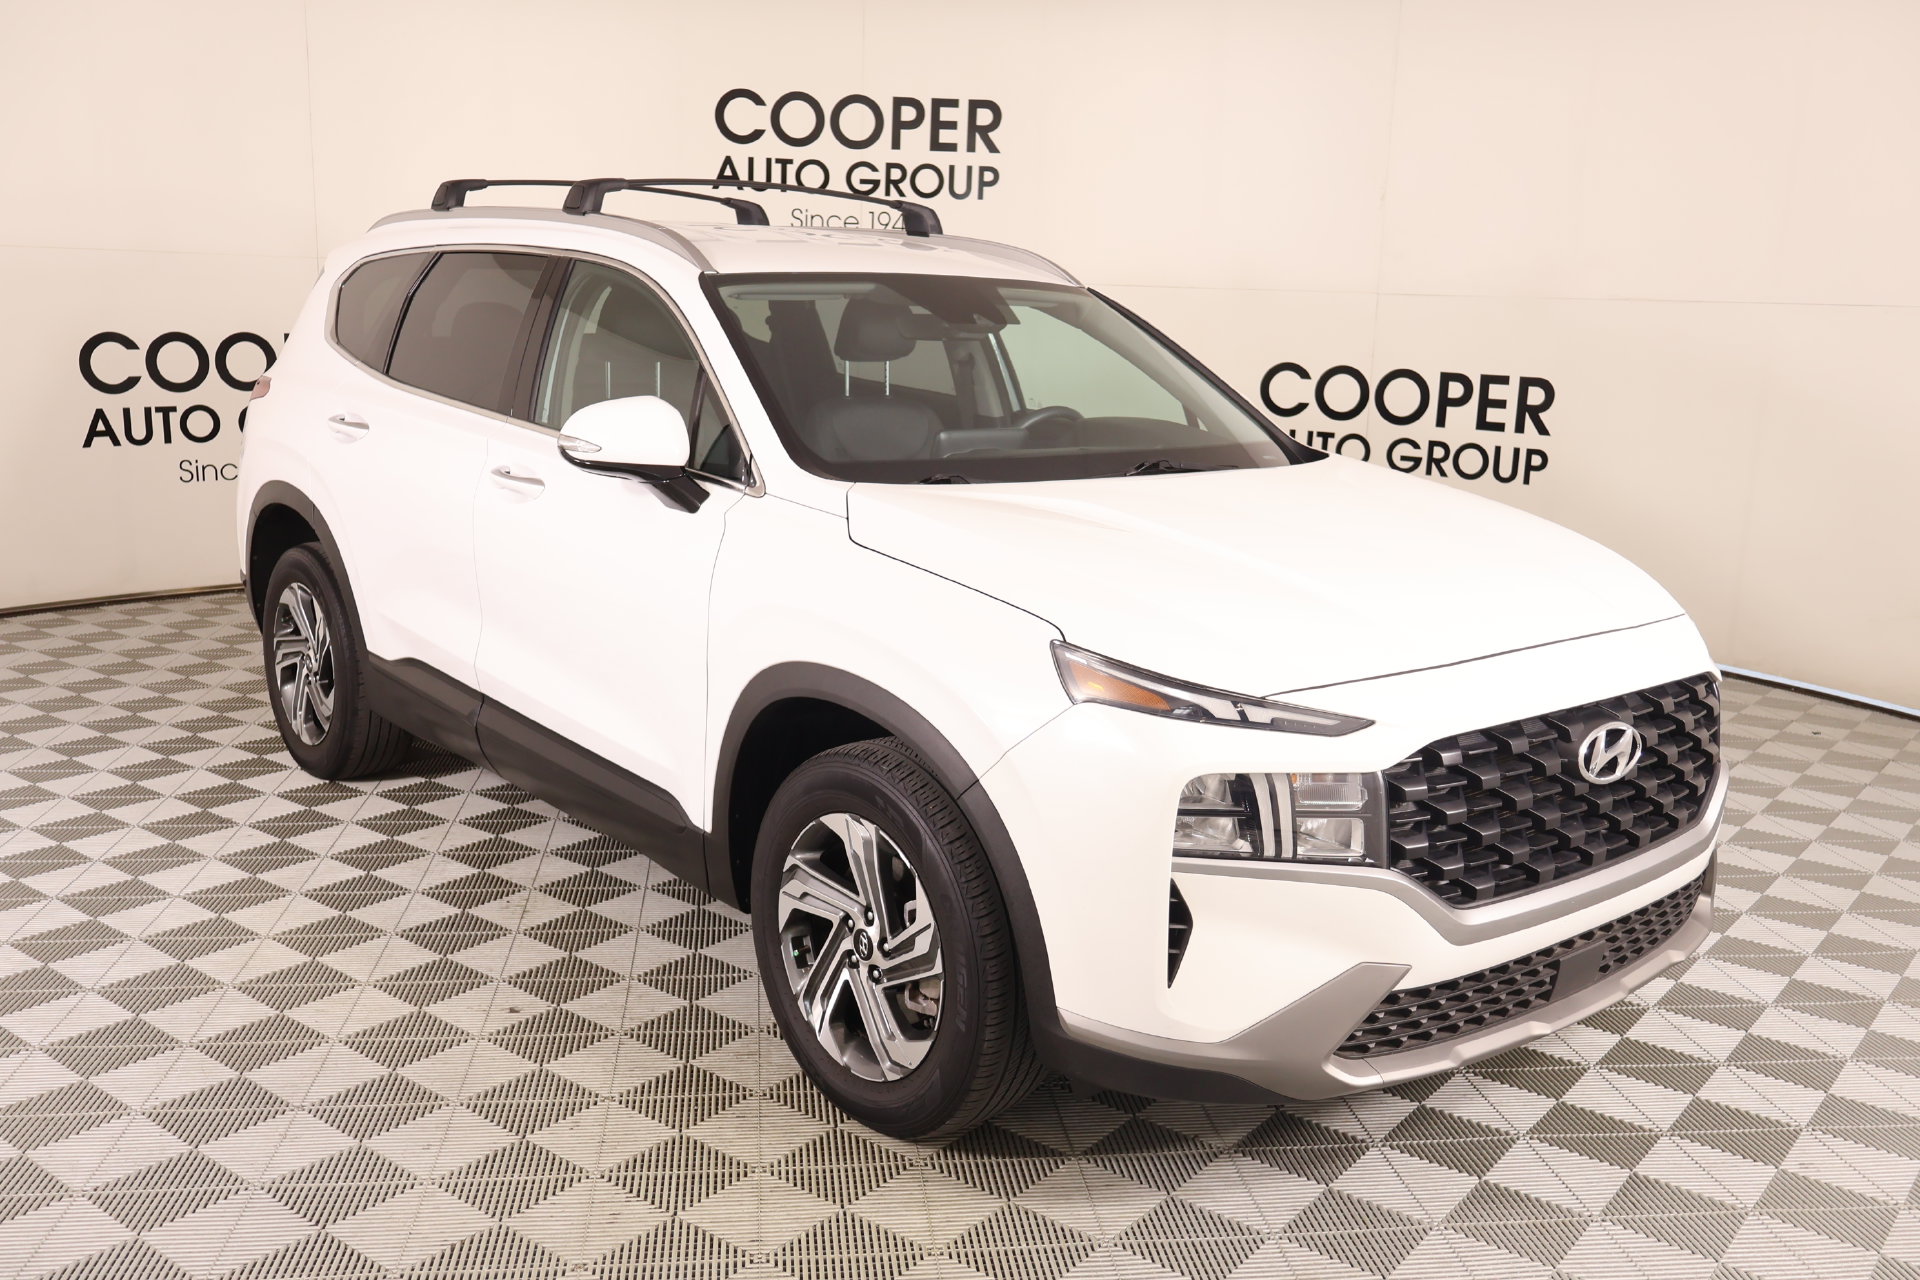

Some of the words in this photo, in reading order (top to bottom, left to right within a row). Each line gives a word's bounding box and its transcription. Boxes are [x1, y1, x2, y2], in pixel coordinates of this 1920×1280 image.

[715, 88, 1002, 154] COOPER
[712, 155, 830, 194] AUTO
[846, 161, 1000, 200] GROUP
[790, 207, 860, 229] Since
[79, 331, 290, 394] COO
[1260, 362, 1556, 436] COOPER
[82, 404, 221, 448] AUTO
[179, 459, 239, 483] Sinc
[1386, 437, 1548, 485] GROUP
